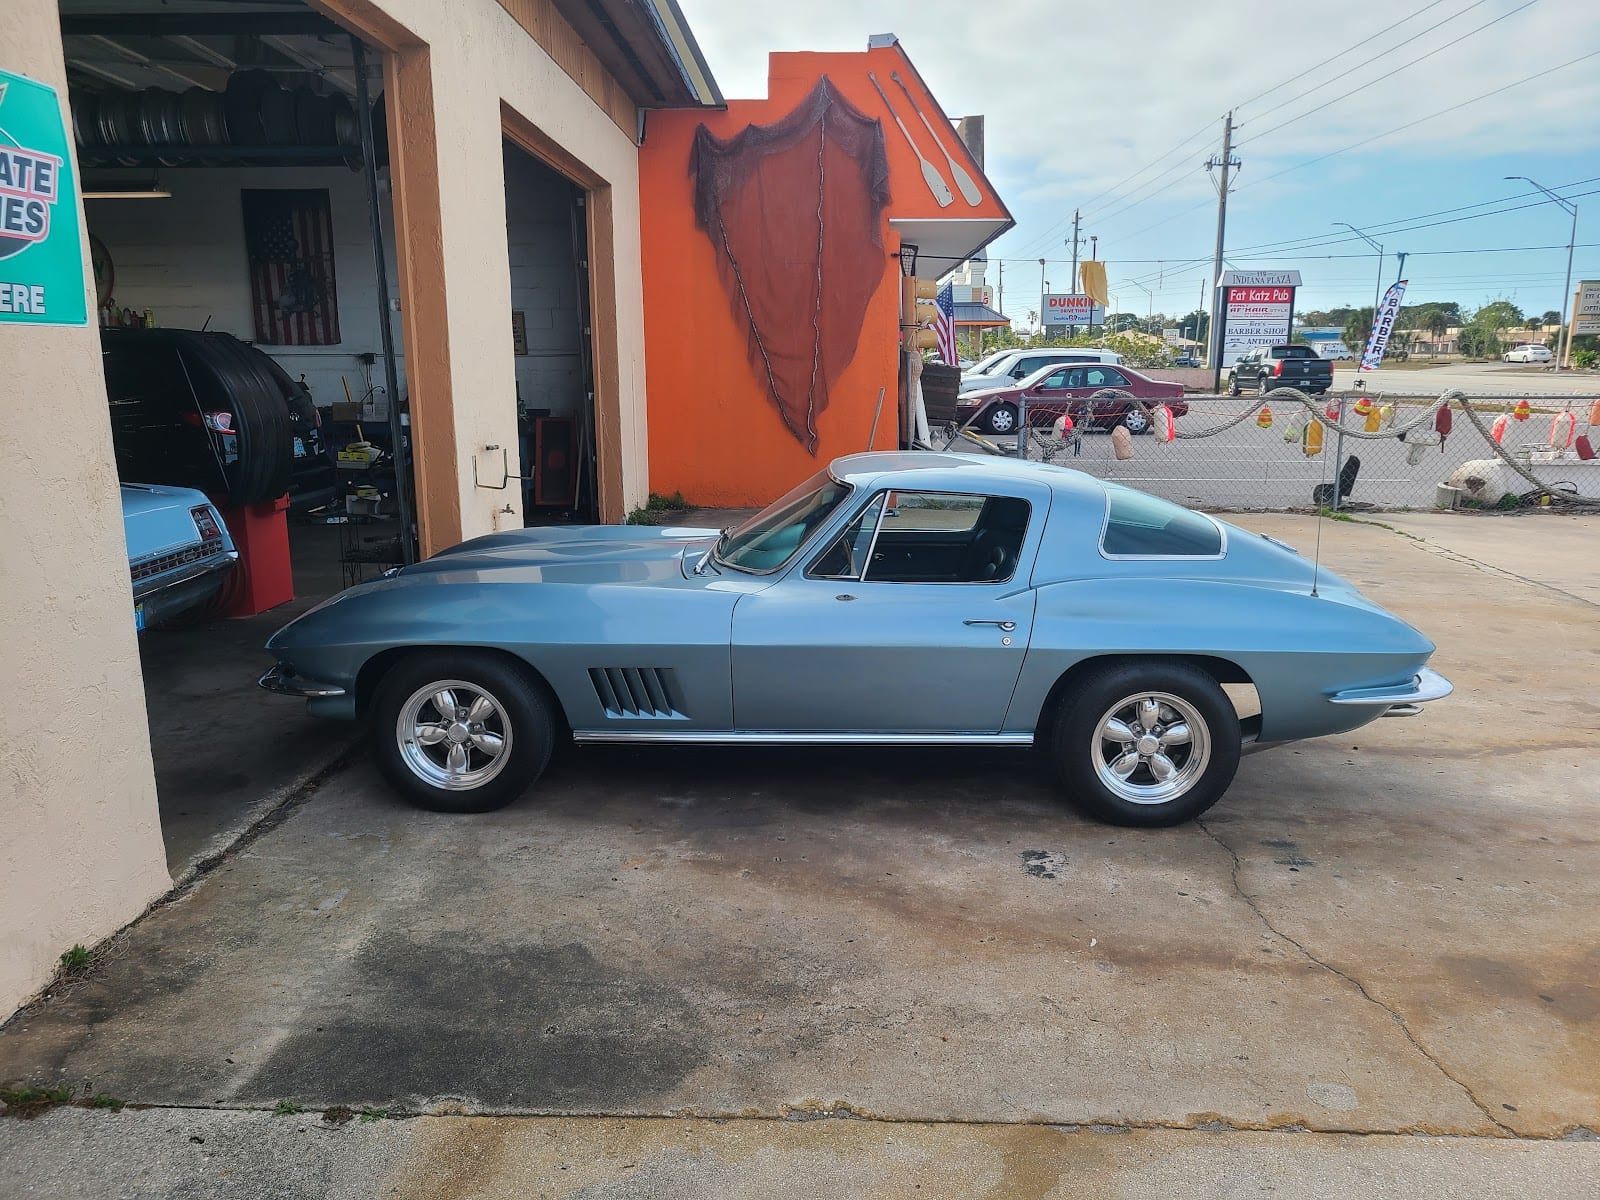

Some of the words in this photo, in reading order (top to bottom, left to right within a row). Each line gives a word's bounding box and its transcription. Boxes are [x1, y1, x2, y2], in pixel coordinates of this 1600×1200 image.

[0, 152, 52, 194] ATE
[0, 196, 44, 234] ES
[1230, 290, 1246, 301] Fat
[1250, 290, 1270, 300] Katz
[1272, 289, 1289, 300] Pub
[1233, 274, 1264, 284] INDIANA
[1267, 274, 1292, 284] PLAZA
[0, 282, 46, 314] ERE
[1372, 299, 1398, 355] BARBER
